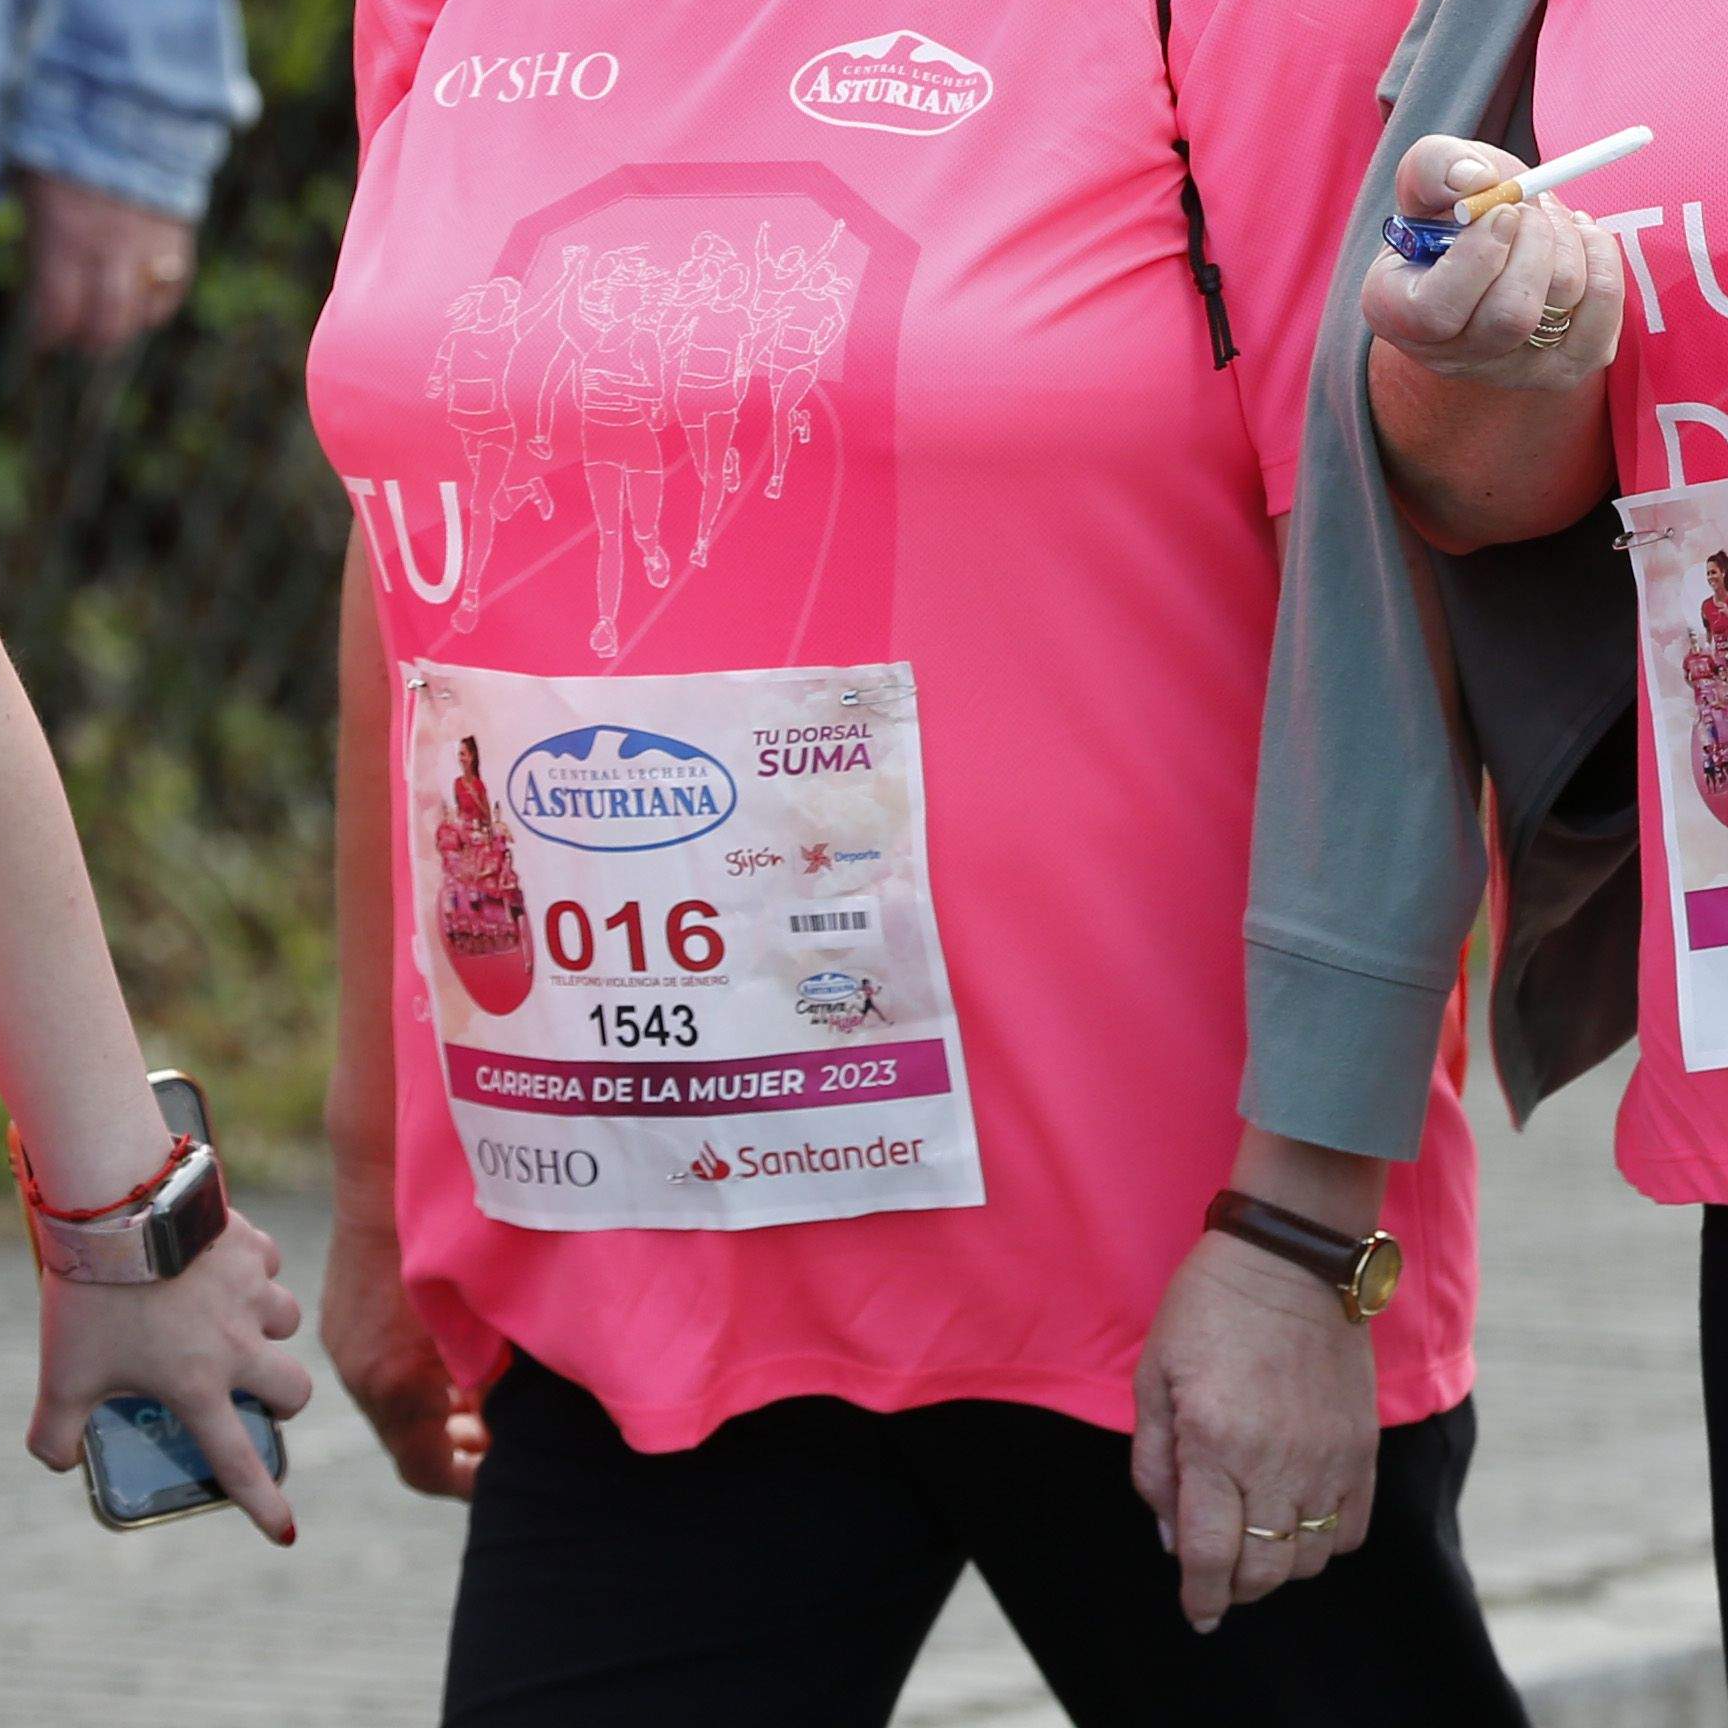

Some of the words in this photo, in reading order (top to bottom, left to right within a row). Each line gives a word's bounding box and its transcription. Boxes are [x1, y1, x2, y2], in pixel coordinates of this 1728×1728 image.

[433, 51, 620, 108] OYSHO
[801, 65, 977, 116] ASTURIANA
[842, 63, 905, 76] CENTRAL
[753, 729, 779, 746] TU
[786, 723, 874, 745] DORSAL
[547, 768, 621, 781] CENTRAL
[627, 766, 709, 780] LECHERA
[757, 743, 872, 778] SUMA
[522, 770, 720, 819] ASTURIANA
[724, 846, 785, 876] gijón
[544, 899, 726, 973] 016
[589, 1003, 699, 1048] 1543
[475, 1066, 586, 1102] CARRERA
[592, 1077, 634, 1103] DE
[641, 1077, 681, 1103] LA
[688, 1068, 806, 1103] MUJER
[819, 1058, 898, 1092] 2023
[477, 1138, 598, 1187] OYSHO
[737, 1135, 923, 1178] Santander
